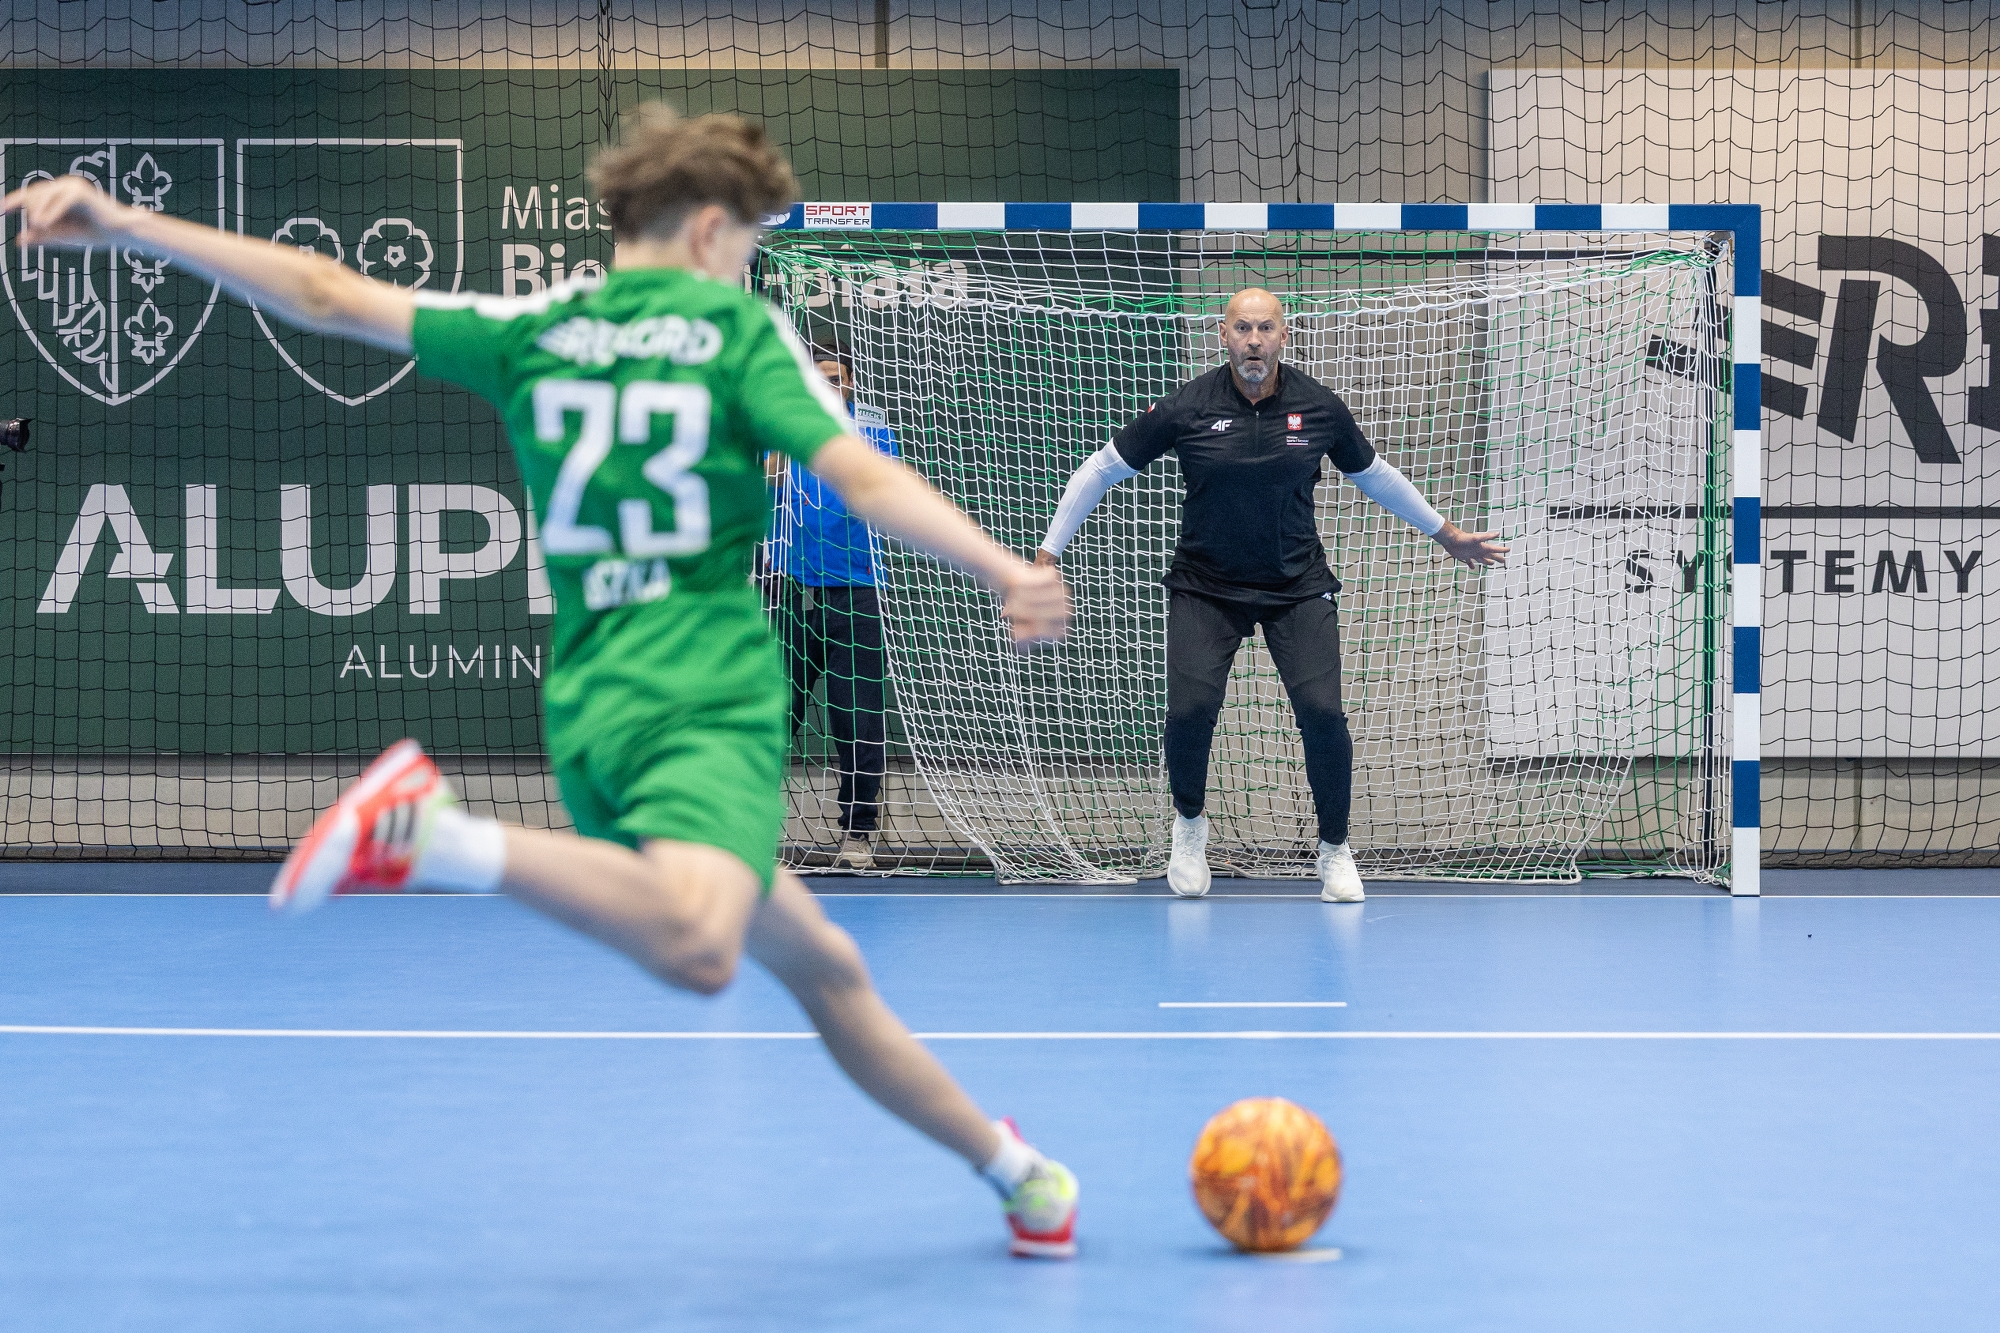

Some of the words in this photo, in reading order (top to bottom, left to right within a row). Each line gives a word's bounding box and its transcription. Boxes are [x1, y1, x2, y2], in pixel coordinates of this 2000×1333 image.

[501, 184, 613, 231] Mias
[805, 205, 870, 216] SPORT
[805, 217, 870, 226] TRANSFER
[1210, 419, 1233, 432] 4F
[532, 379, 712, 559] 23
[1625, 549, 1983, 594] SYTEMY
[339, 644, 542, 679] ALUMIN
